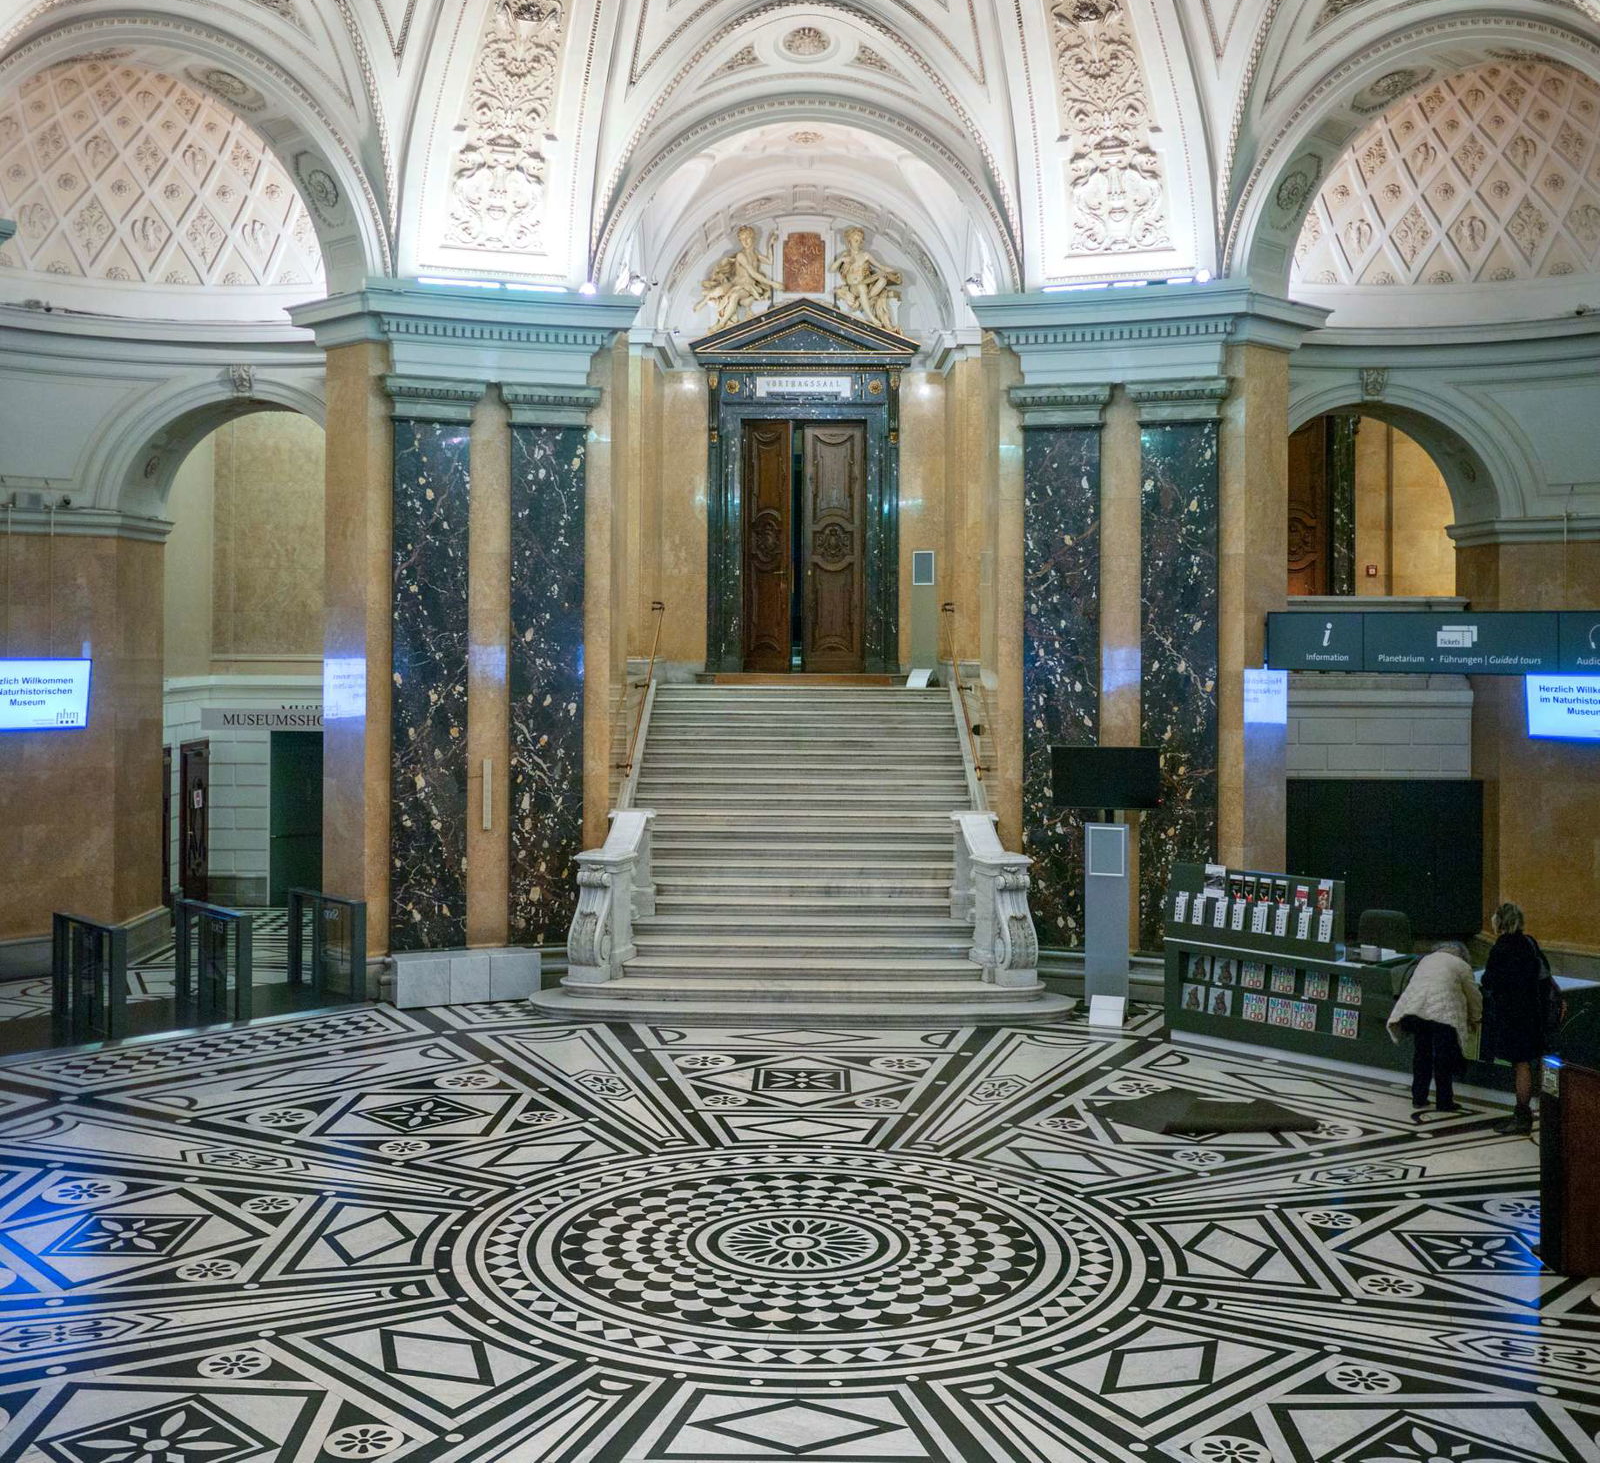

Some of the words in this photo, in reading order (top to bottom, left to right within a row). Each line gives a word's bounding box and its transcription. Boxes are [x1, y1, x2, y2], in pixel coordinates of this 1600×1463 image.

[1305, 653, 1349, 661] Information
[1378, 654, 1425, 663] Planetarium
[1439, 655, 1483, 665] Führungen
[1489, 656, 1518, 664] Guided
[1520, 657, 1542, 665] tours
[22, 677, 74, 685] Willkommen
[1539, 684, 1574, 694] Herzlich
[9, 698, 46, 706] Museum
